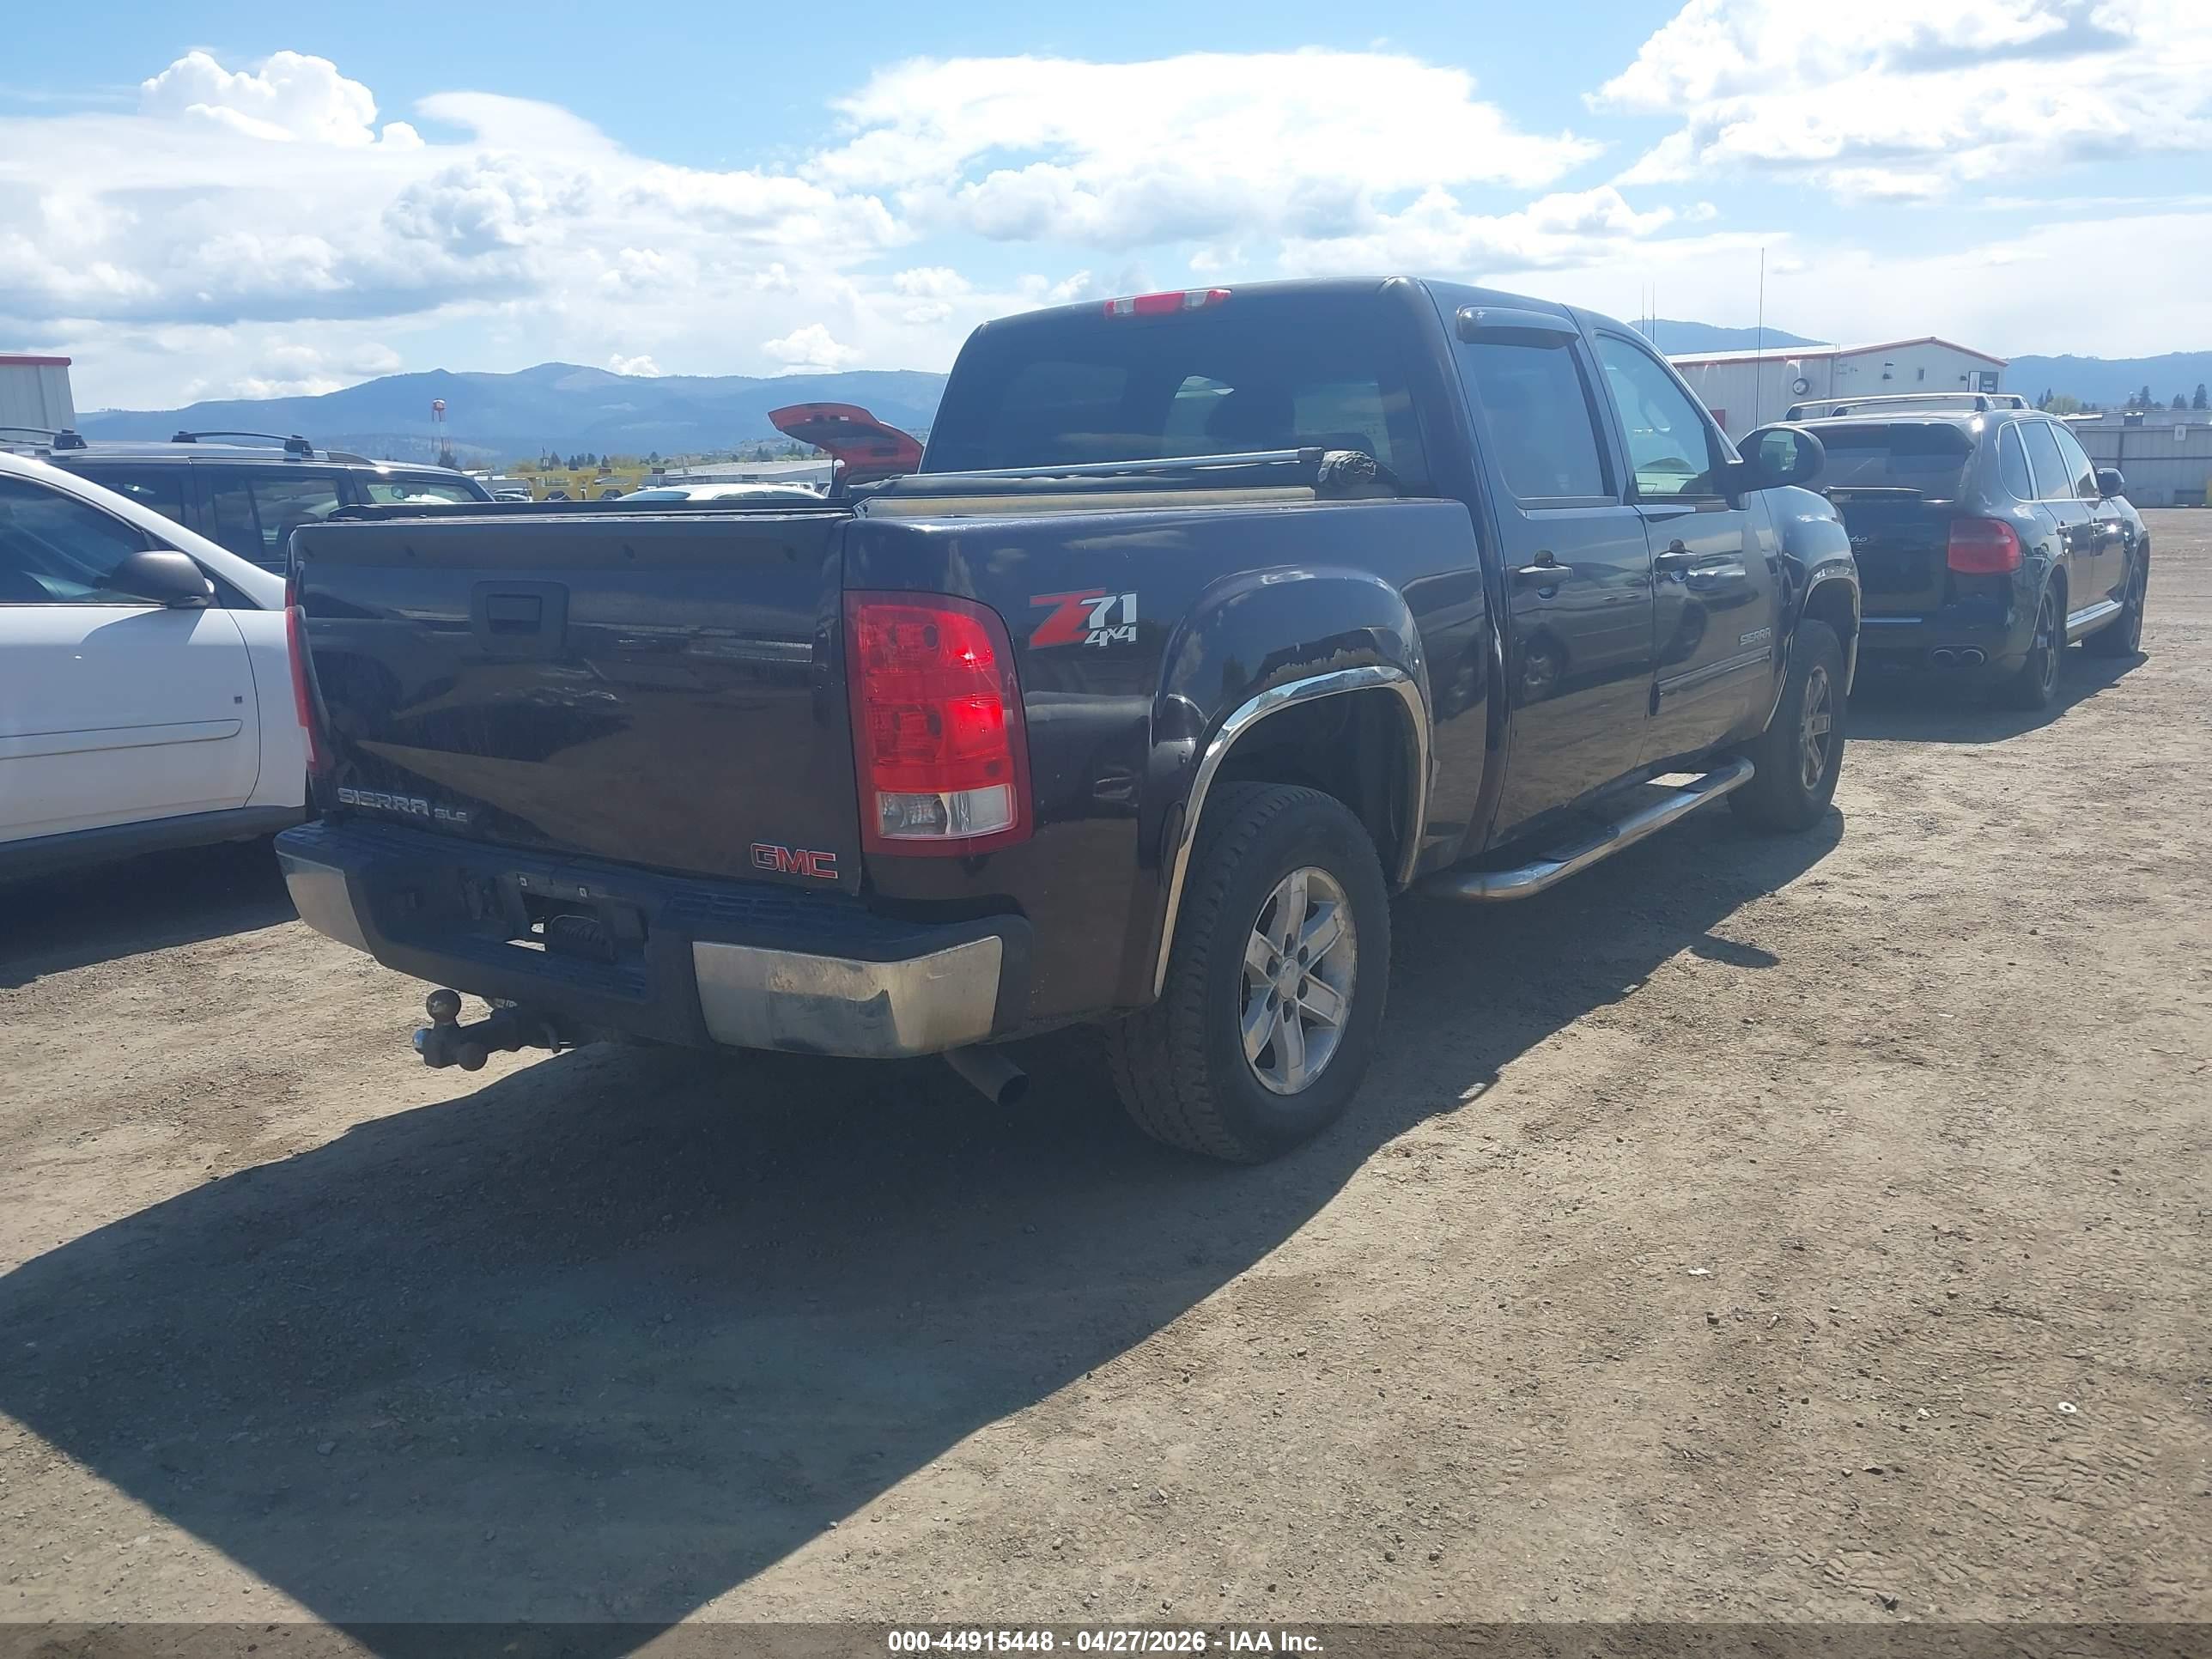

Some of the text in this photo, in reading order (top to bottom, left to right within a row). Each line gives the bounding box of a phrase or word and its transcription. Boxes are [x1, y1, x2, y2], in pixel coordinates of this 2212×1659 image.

[1030, 587, 1137, 649] Z71
[1739, 627, 1771, 646] SIERRA
[337, 787, 468, 822] SIERRA SLE
[750, 842, 838, 879] GMC
